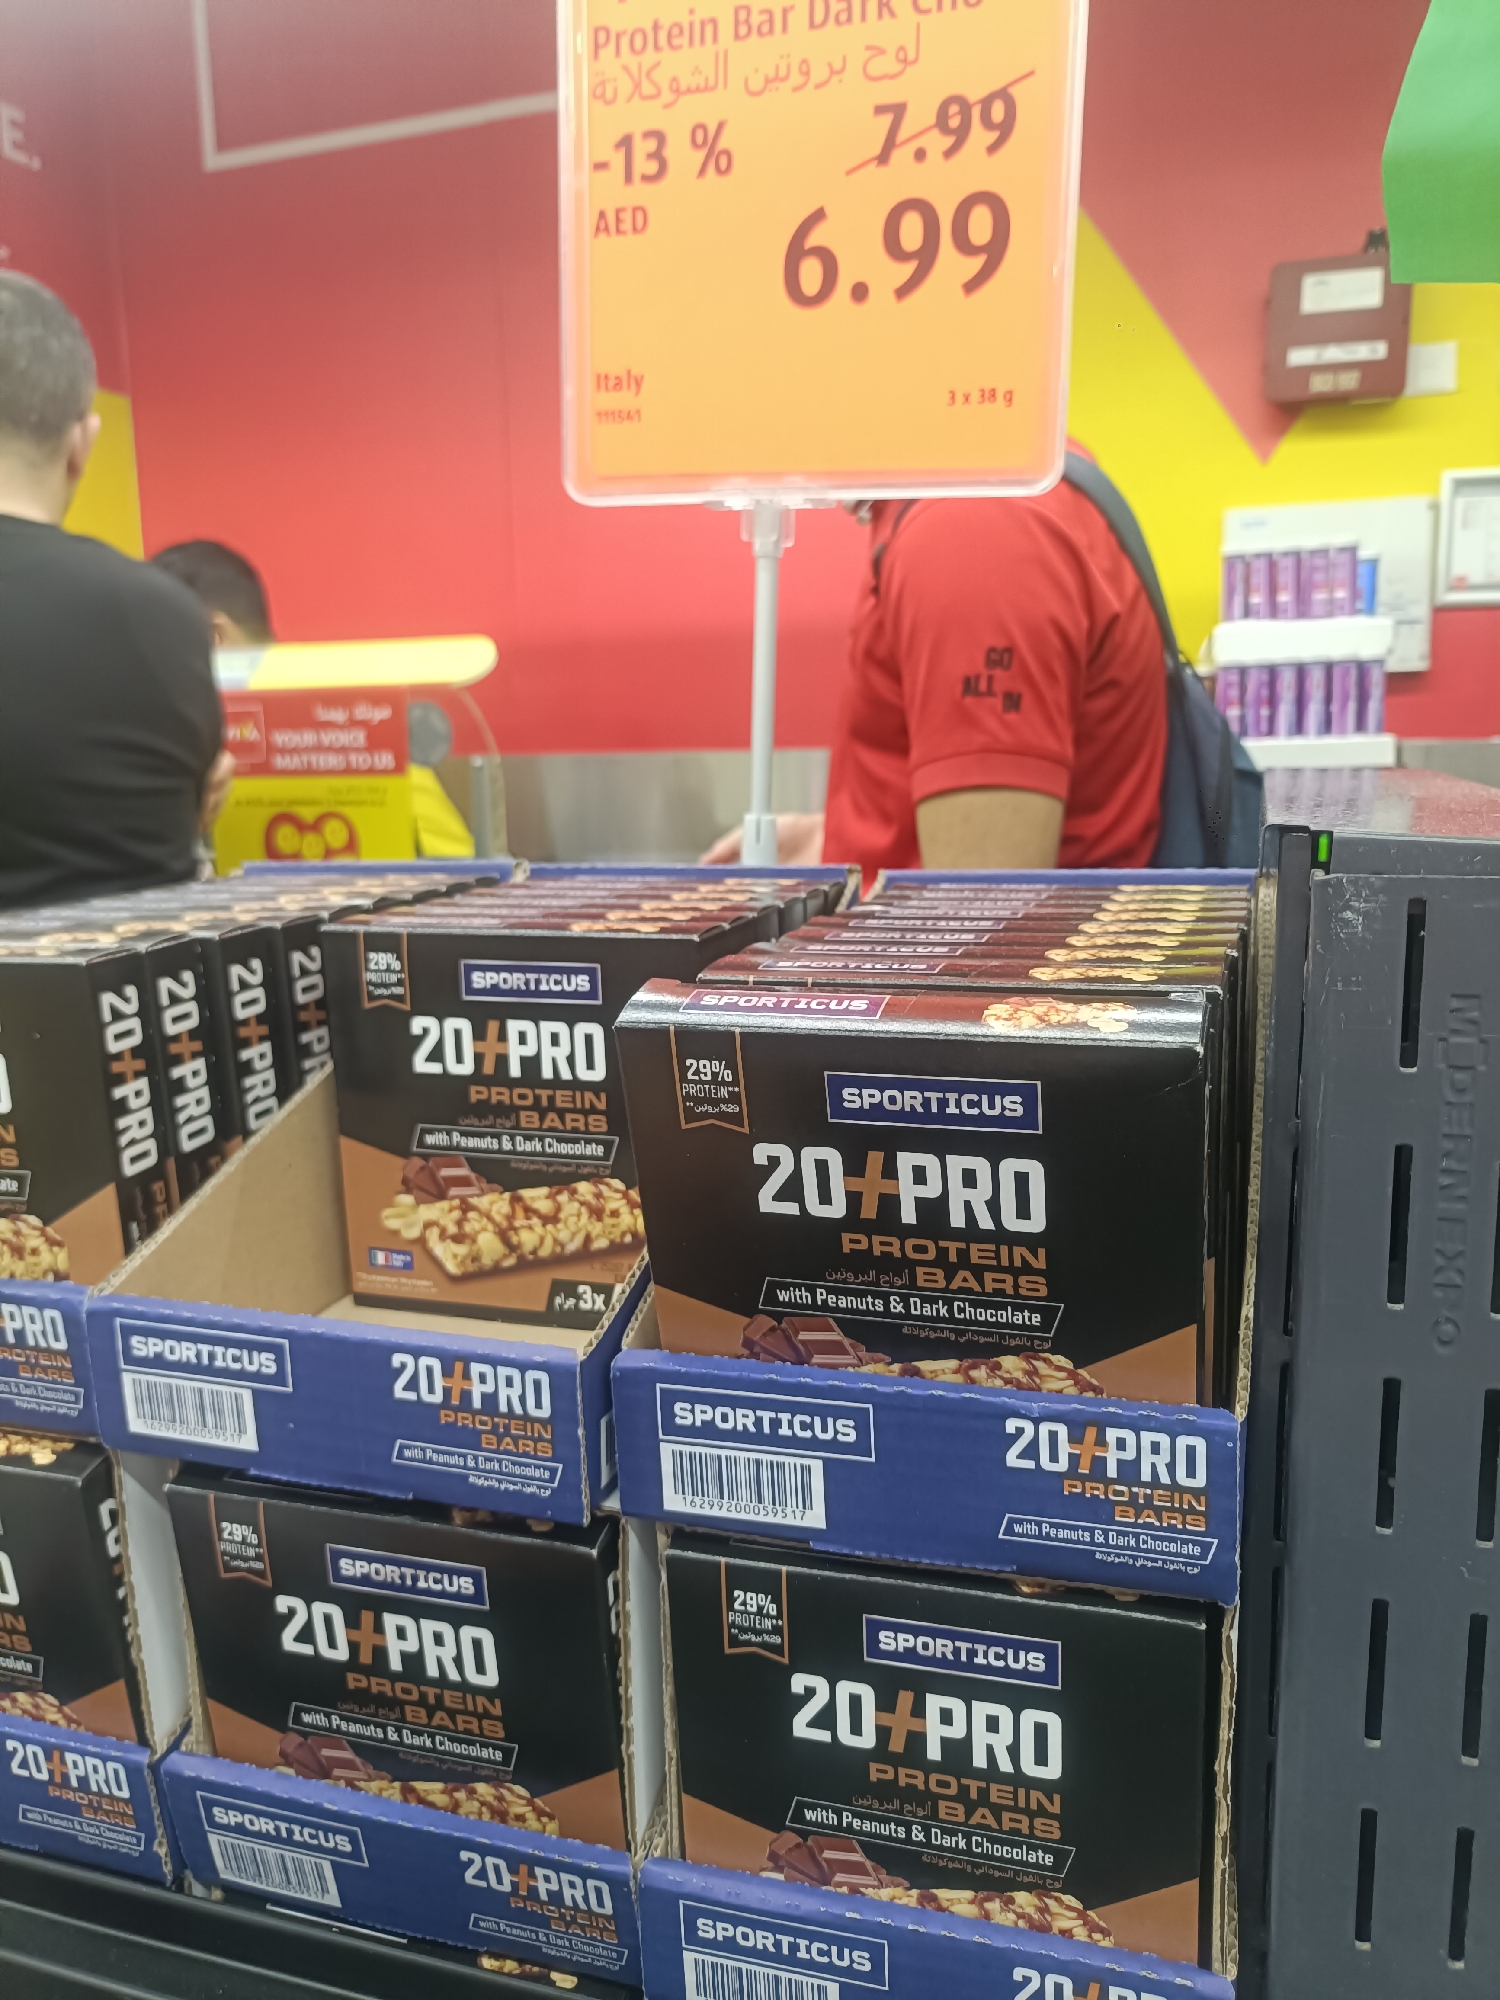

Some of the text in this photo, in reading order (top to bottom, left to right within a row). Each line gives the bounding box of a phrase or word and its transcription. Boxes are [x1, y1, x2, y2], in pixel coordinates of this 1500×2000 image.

[593, 15, 719, 61] Protein
[734, 4, 795, 42] Bar
[863, 22, 921, 81] لوح
[744, 53, 847, 95] بروتين
[873, 93, 1017, 168] 7.99
[593, 119, 734, 186] -13 %
[593, 205, 649, 238] AED
[783, 190, 1011, 310] 6.99
[596, 369, 645, 397] Italy
[947, 388, 1013, 408] 3 x 38 g
[471, 971, 591, 991] SPORTICUS
[776, 961, 927, 970] SPORTICUS
[699, 994, 869, 1011] SPORTICUS
[156, 969, 216, 1154] 20+PRO
[409, 1015, 607, 1082] 20+PRO
[99, 984, 159, 1178] 20+PRO
[685, 1058, 733, 1082] 29%
[469, 1085, 607, 1110] PROTEIN
[841, 1087, 1024, 1117] SPORTICUS
[519, 1110, 608, 1132] BARS
[425, 1131, 604, 1156] with Peanuts & Dark Chocolate
[752, 1142, 1047, 1234] 20+PRO
[841, 1232, 1046, 1269] PROTEIN
[825, 1267, 909, 1287] ألواح البروتين
[916, 1266, 1048, 1297] BARS
[776, 1287, 1042, 1327] with Peanuts & Dark Chocolate
[130, 1335, 277, 1375] SPORTICUS
[19, 1364, 75, 1384] BARS
[391, 1352, 552, 1418] 20+PRO
[439, 1409, 552, 1439] PROTEIN
[673, 1401, 857, 1443] SPORTICUS
[404, 1447, 550, 1479] with Peanuts & Dark Chocolate
[481, 1433, 553, 1457] BARS
[1005, 1417, 1207, 1488] 20+PRO
[682, 1496, 806, 1521] 16299200059517
[1063, 1479, 1206, 1511] PROTEIN
[220, 1522, 259, 1545] 29%
[1114, 1506, 1206, 1531] BARS
[1013, 1521, 1201, 1556] with Peanuts & Dark Chocolate
[338, 1557, 475, 1595] SPORTICUS
[733, 1589, 777, 1616] 29%
[274, 1594, 499, 1688] 20+PRO
[878, 1630, 1046, 1673] SPORTICUS
[346, 1672, 503, 1717] PROTEIN
[301, 1710, 503, 1762] with Peanuts & Dark Chocolate
[404, 1705, 505, 1739] BARS
[790, 1672, 1062, 1781] 20+PRO
[6, 1739, 130, 1799] 20+PRO
[48, 1785, 134, 1815] PROTEIN
[852, 1794, 931, 1818] ألواح البروتين
[868, 1761, 1061, 1815] PROTEIN
[212, 1806, 352, 1853] SPORTICUS
[804, 1807, 1054, 1866] with Peanuts & Dark Chocolate
[938, 1799, 1062, 1840] BARS
[460, 1850, 613, 1916] 20+PRO
[510, 1897, 615, 1931] PROTEIN
[551, 1919, 618, 1944] BARS
[479, 1919, 499, 1932] with
[500, 1923, 536, 1940] Peanuts
[538, 1931, 547, 1942] &
[550, 1934, 570, 1948] Dark
[572, 1938, 617, 1959] Chocolate
[697, 1918, 872, 1972] SPORTICUS
